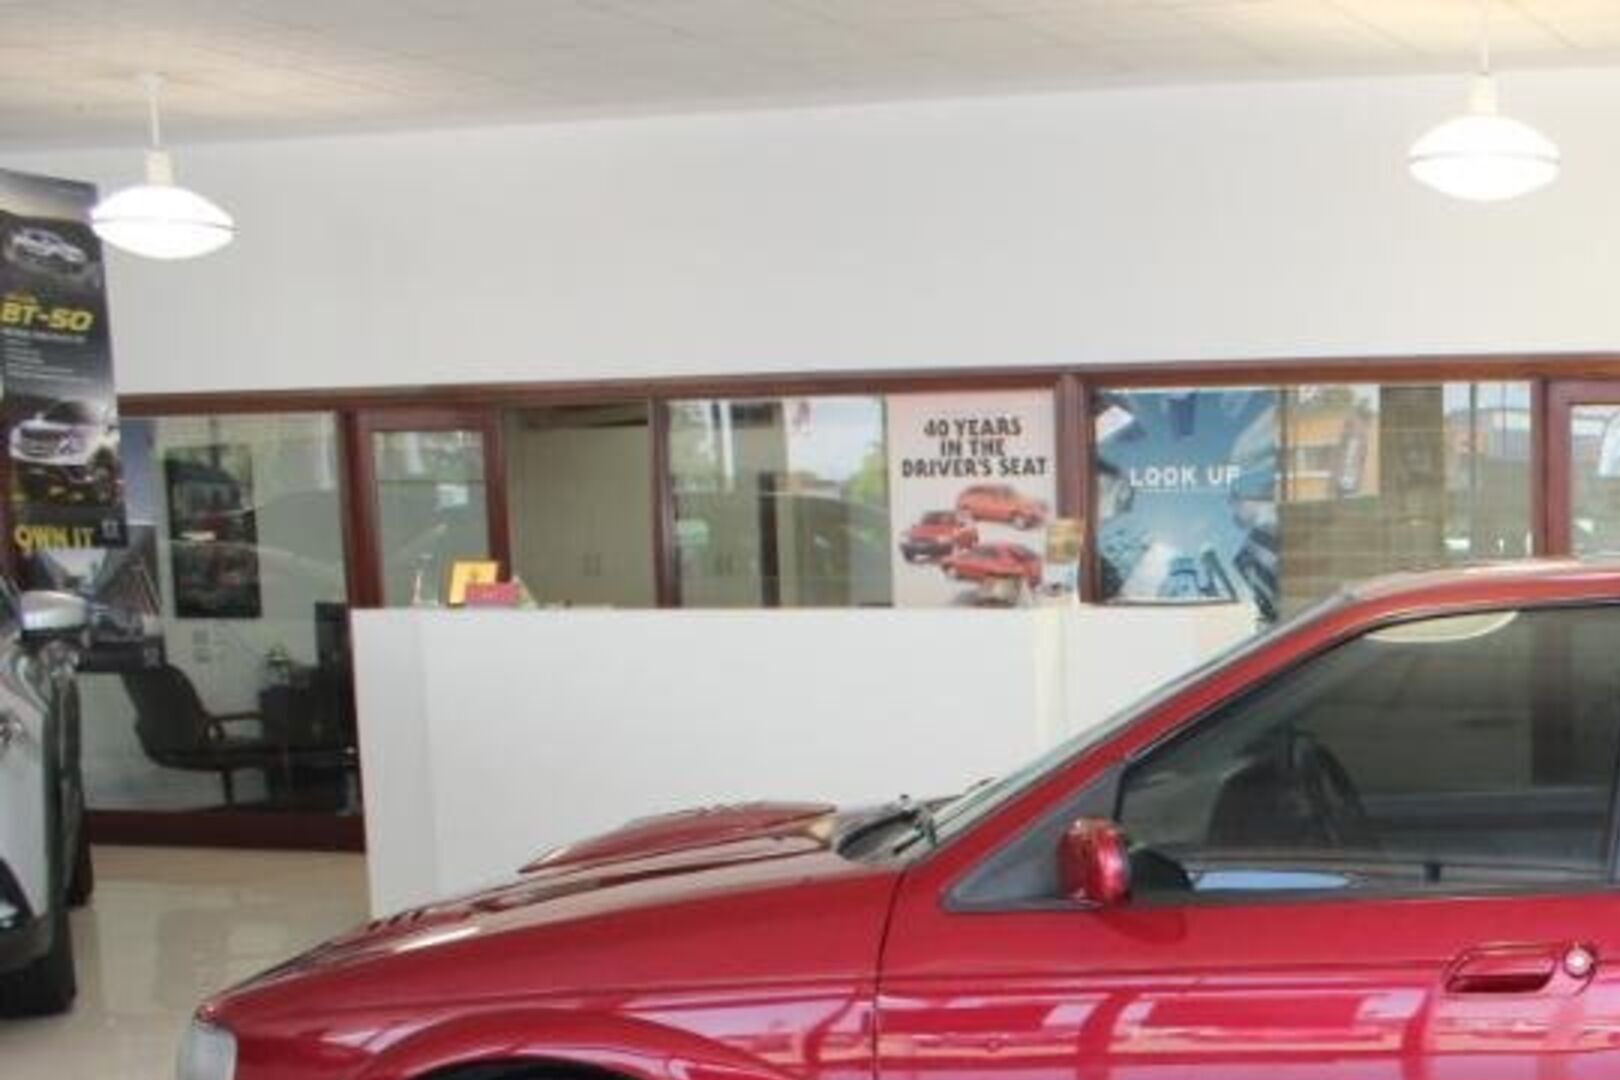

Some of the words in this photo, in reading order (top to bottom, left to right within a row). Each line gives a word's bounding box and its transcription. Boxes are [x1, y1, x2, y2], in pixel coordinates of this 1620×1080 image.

[1, 302, 95, 331] BT-50
[923, 419, 949, 436] 40
[954, 416, 1022, 436] YEARS
[940, 440, 963, 456] IN
[969, 438, 1006, 456] THE
[902, 458, 993, 478] DRIVER'S
[1000, 457, 1047, 477] SEAT
[1130, 465, 1198, 487] LOOK
[1208, 464, 1241, 486] UP
